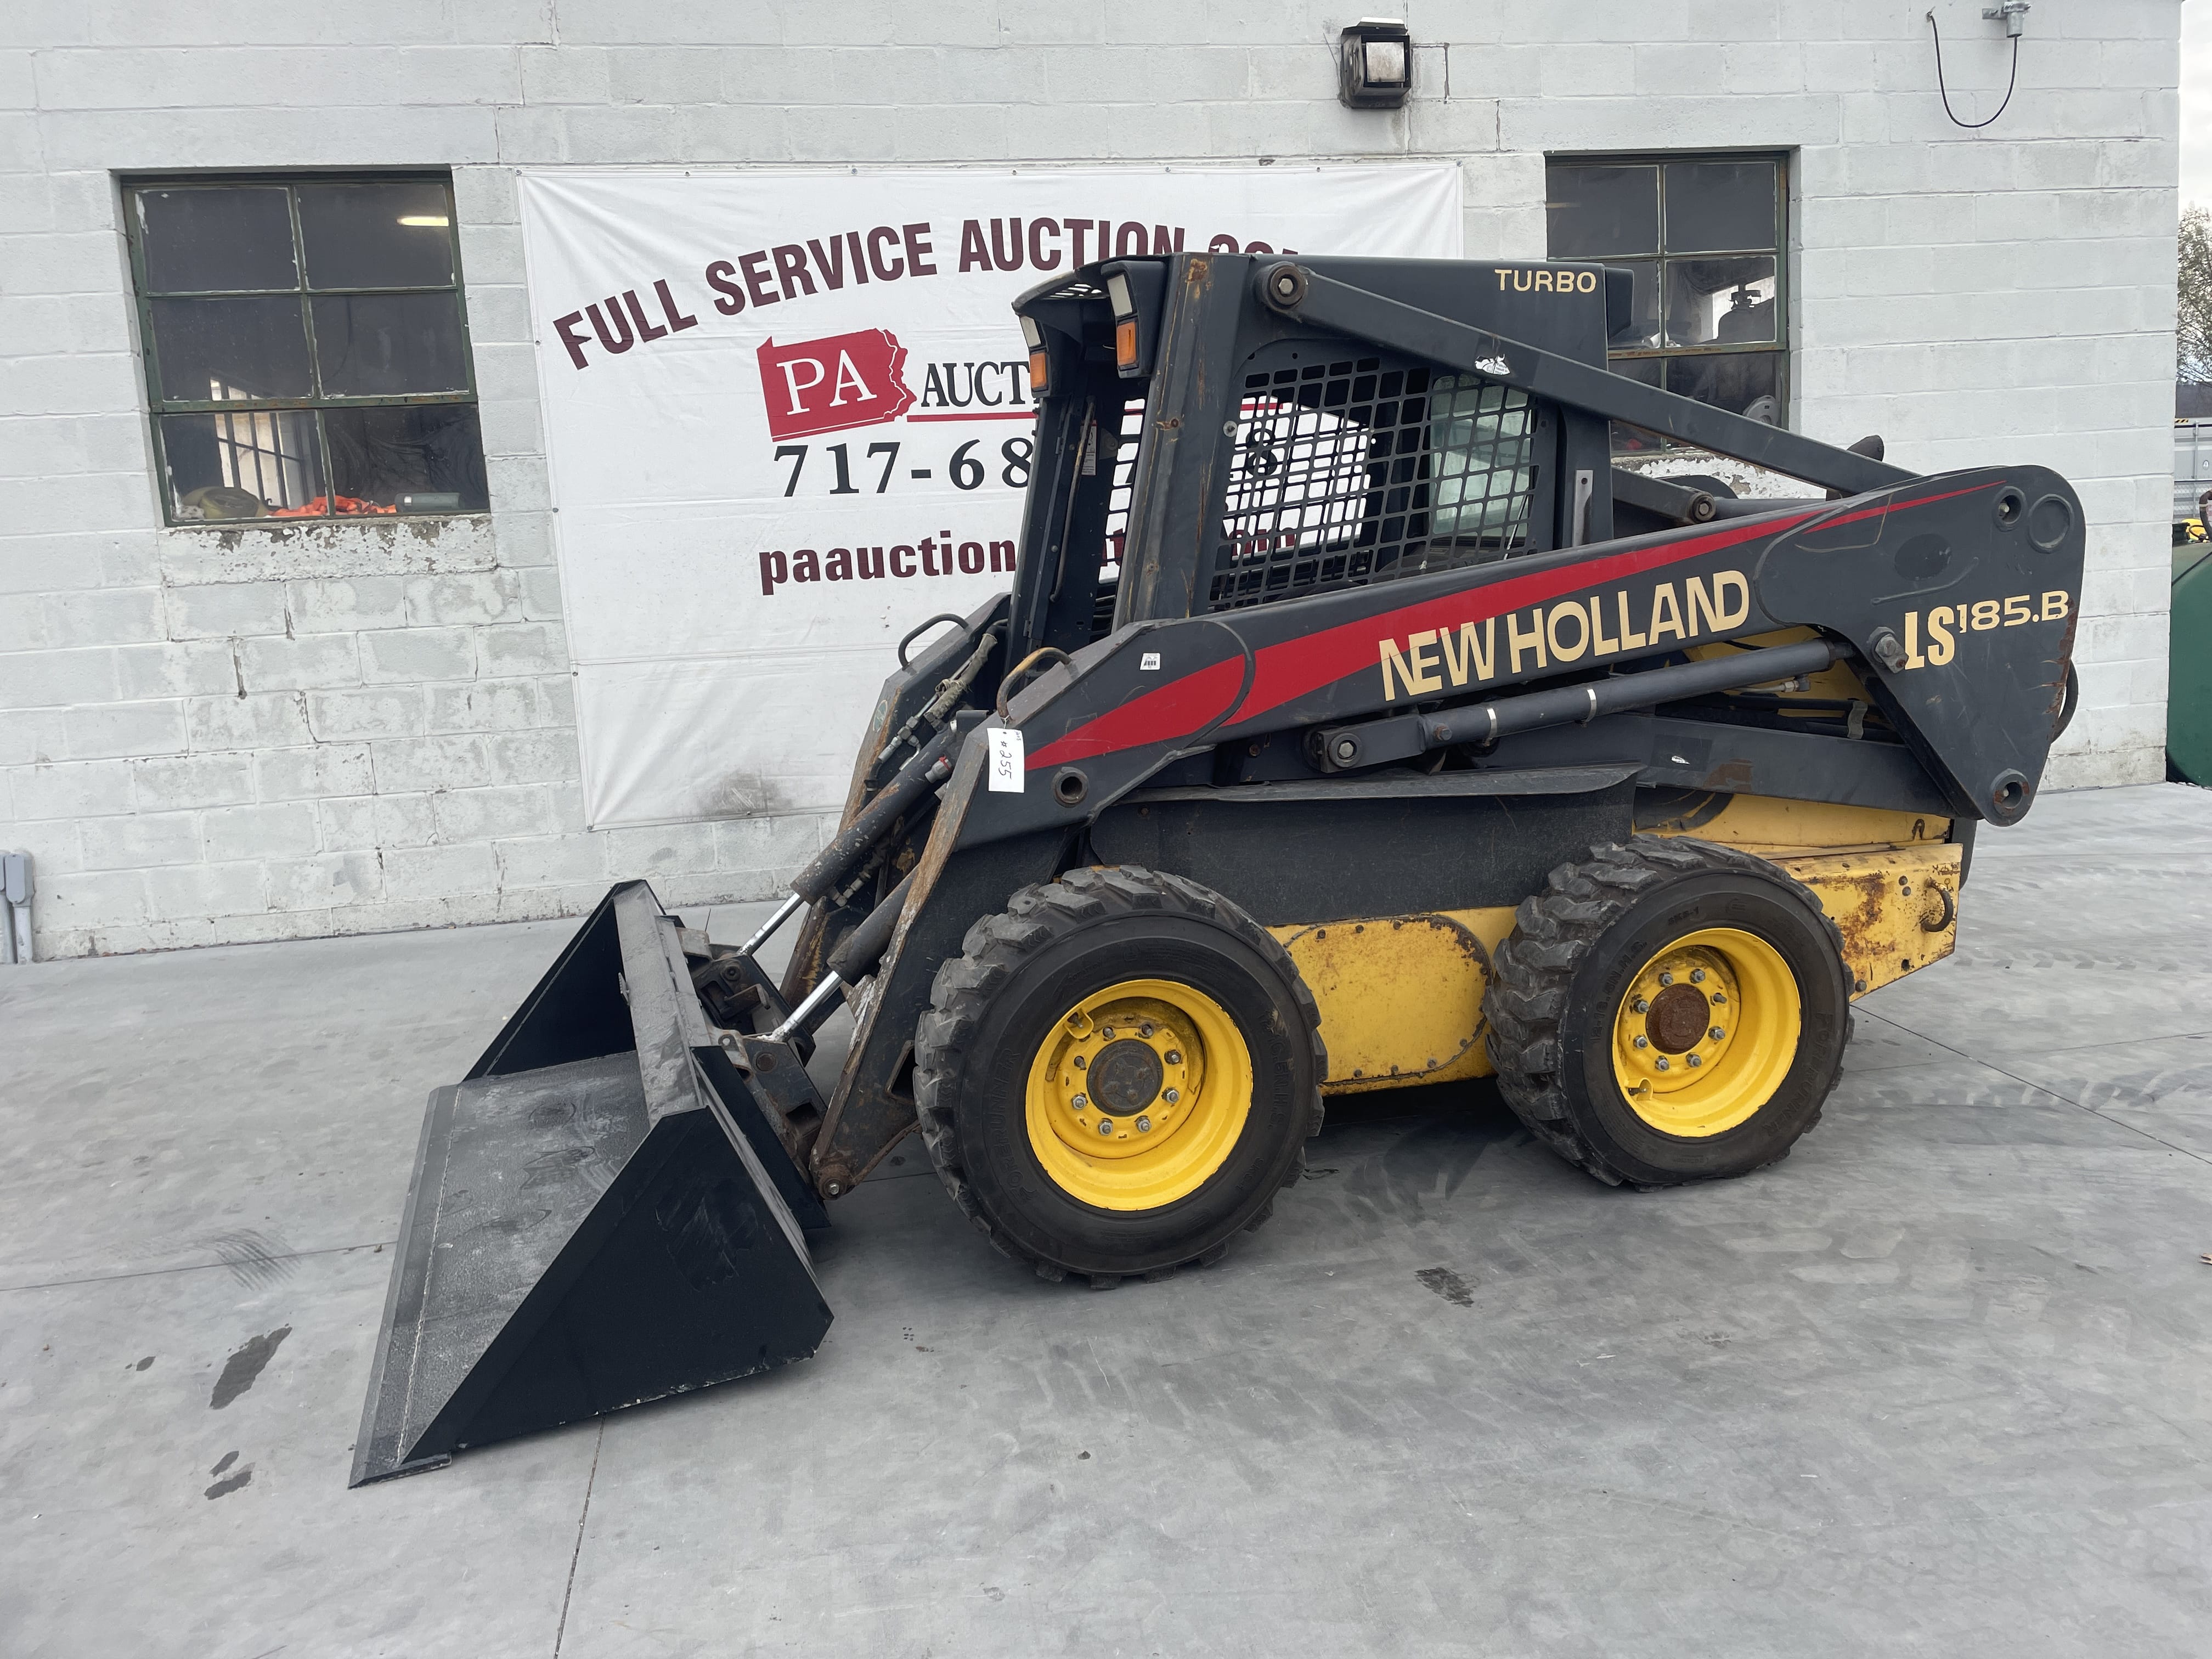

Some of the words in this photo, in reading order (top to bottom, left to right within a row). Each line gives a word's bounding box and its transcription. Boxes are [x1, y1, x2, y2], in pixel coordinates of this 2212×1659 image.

[552, 278, 698, 370] FULL
[705, 222, 938, 315] SERVICE
[1494, 268, 1597, 293] TURBO
[776, 349, 877, 416] PA
[921, 360, 1040, 408] AUCT
[1379, 617, 1496, 702] NEW
[1507, 569, 1750, 674] HOLLAND
[990, 1048, 1037, 1205] FORERUNNER
